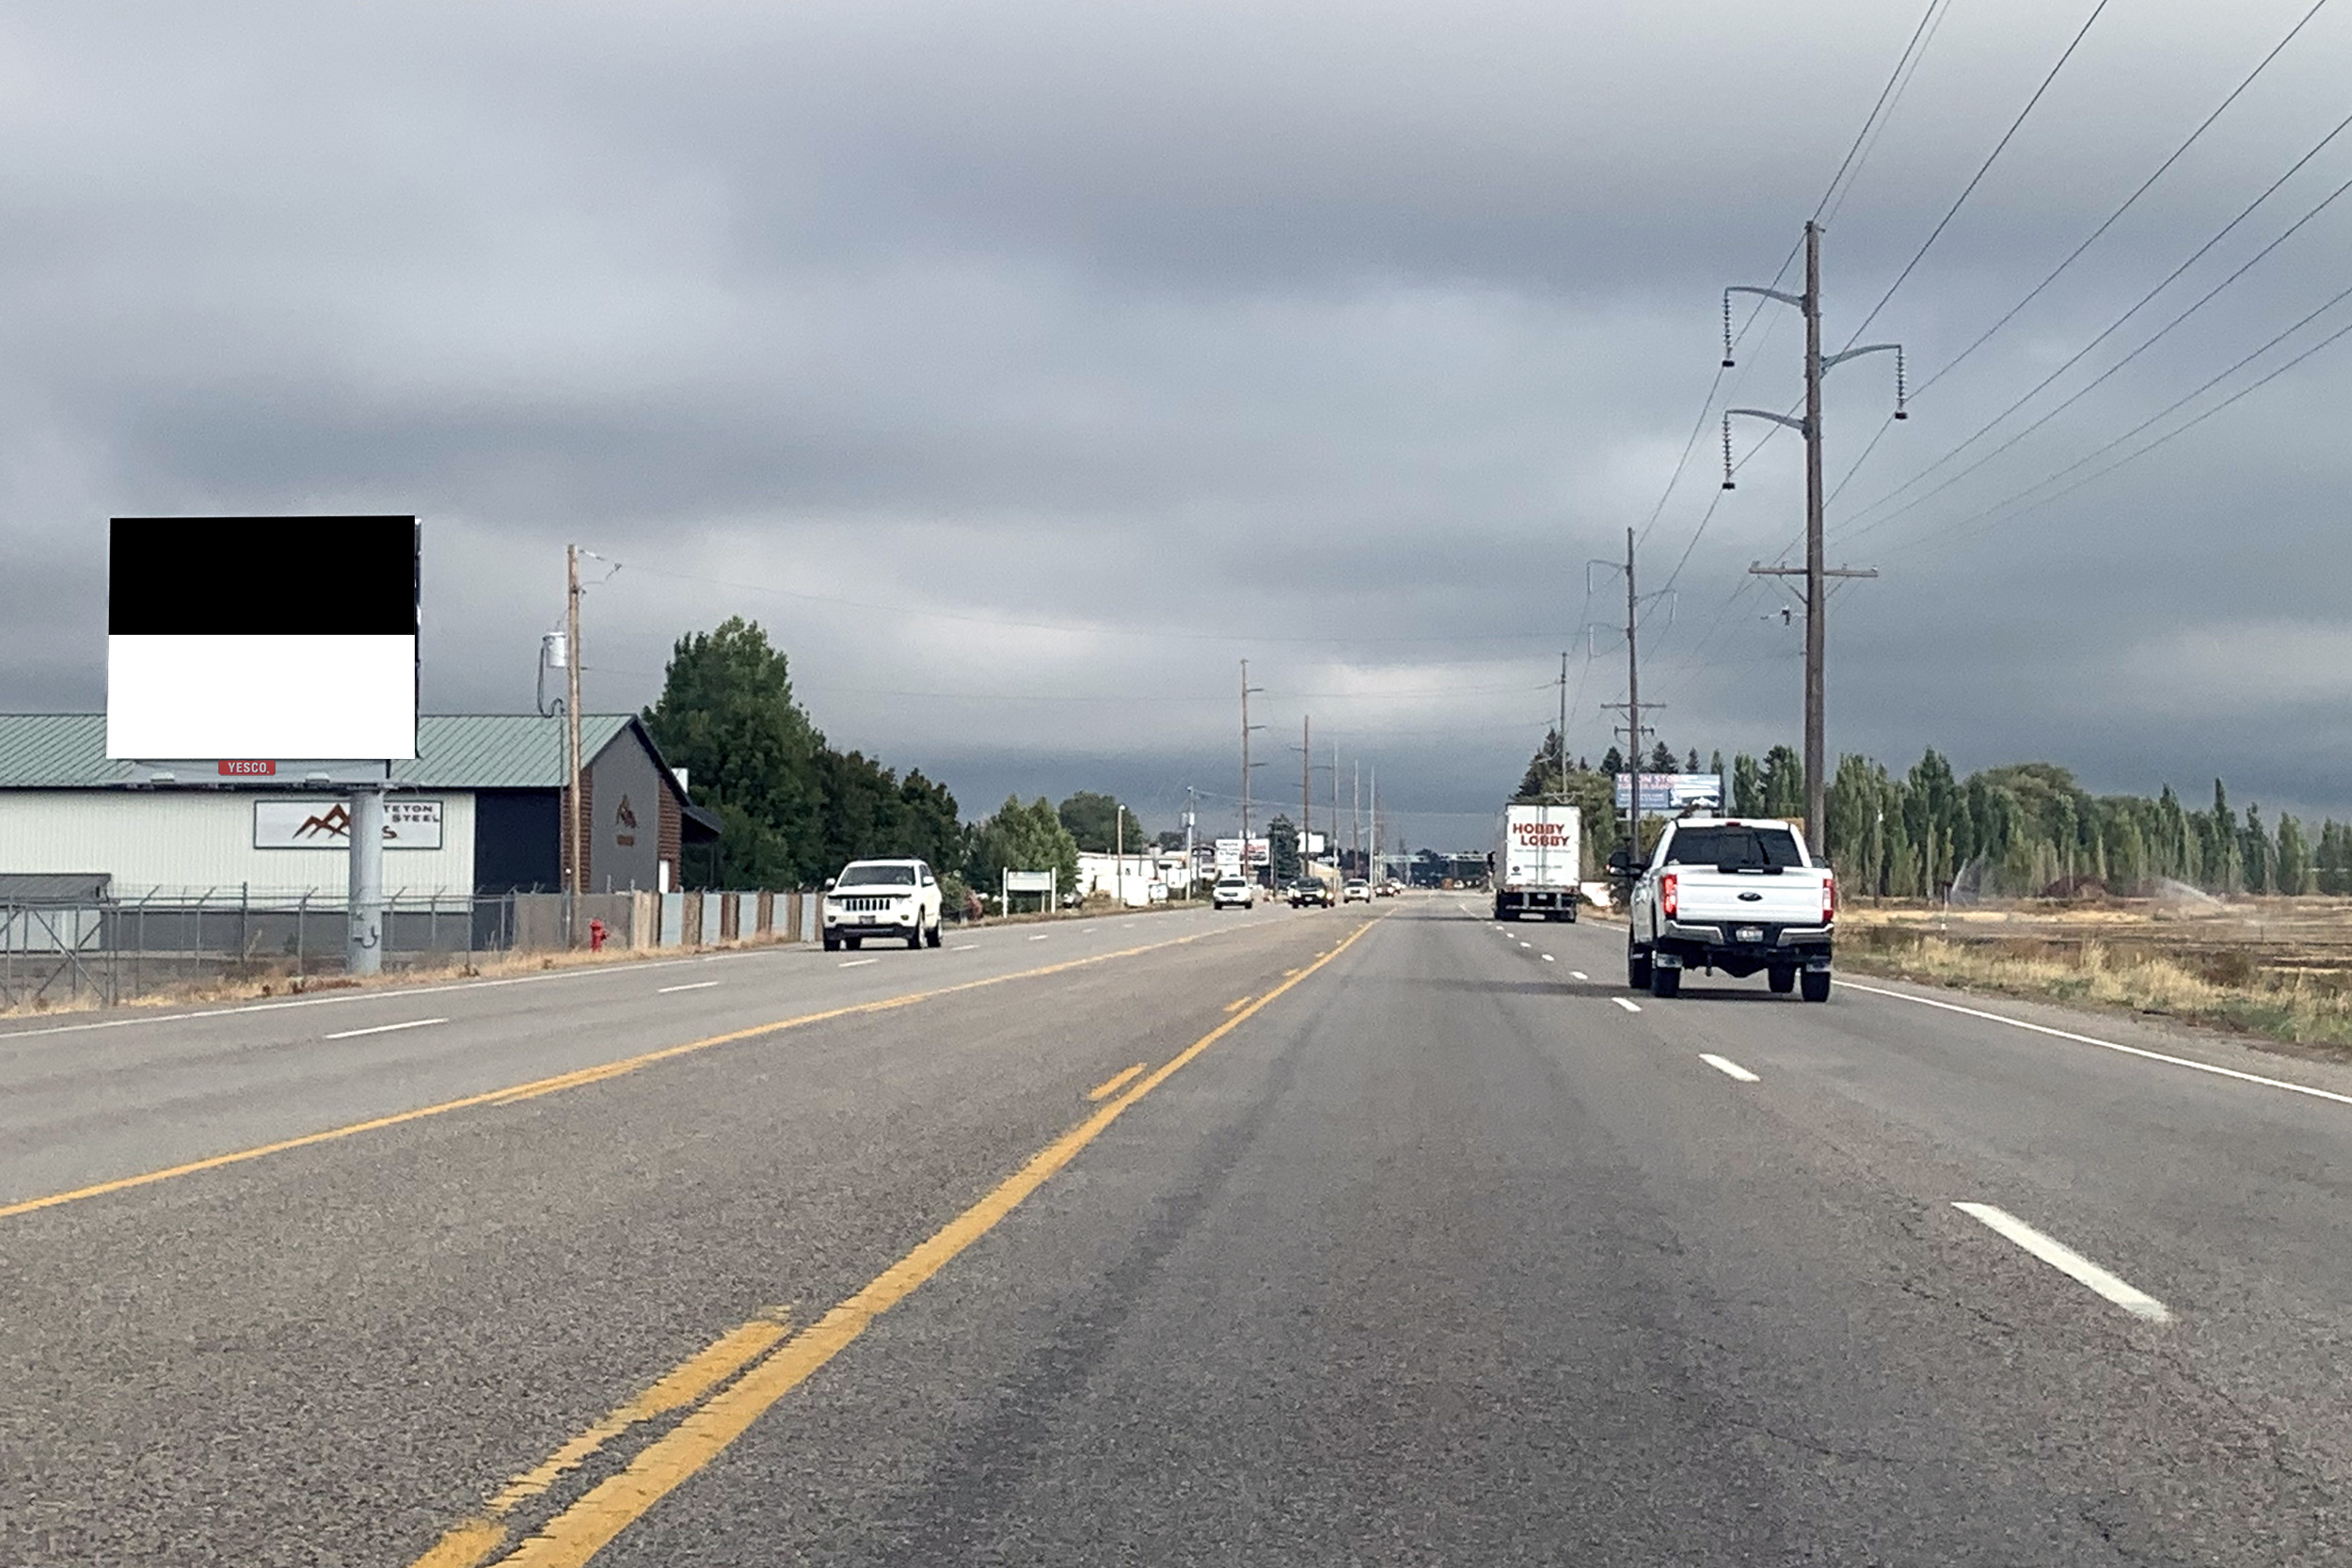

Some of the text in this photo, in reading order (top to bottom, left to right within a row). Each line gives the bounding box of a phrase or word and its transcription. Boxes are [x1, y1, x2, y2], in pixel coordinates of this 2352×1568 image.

[383, 804, 433, 814] TETON
[391, 814, 440, 823] STEEL
[1513, 823, 1565, 834] HOBBY
[1520, 835, 1570, 847] LOBBY
